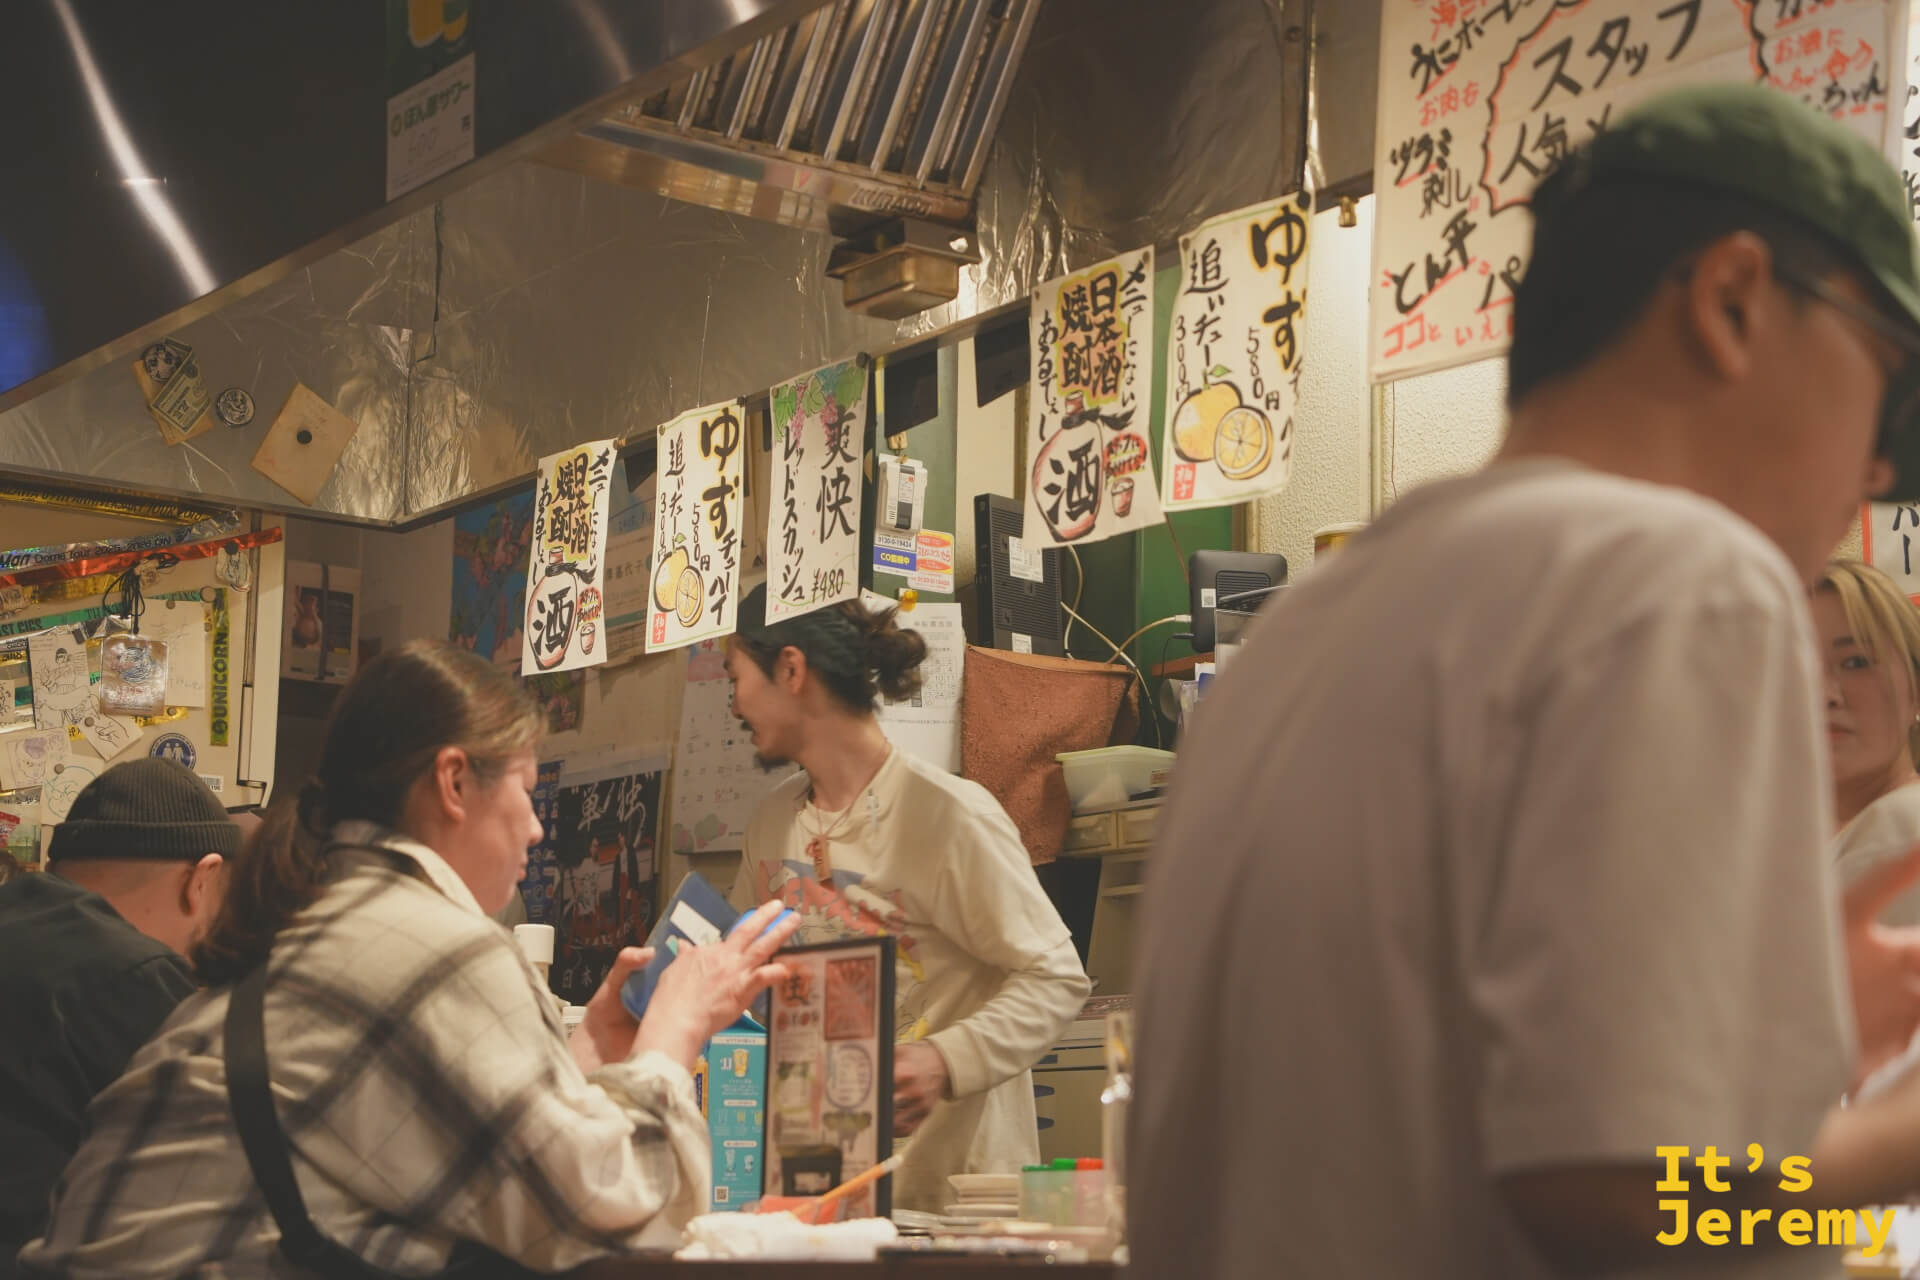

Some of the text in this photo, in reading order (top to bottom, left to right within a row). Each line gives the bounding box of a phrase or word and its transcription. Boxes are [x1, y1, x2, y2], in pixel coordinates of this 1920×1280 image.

[1531, 0, 1705, 112] スタッフ
[1391, 208, 1478, 315] とん平
[1059, 285, 1093, 389] 焼酎
[1089, 271, 1122, 398] 日本酒
[1119, 261, 1148, 408] メニューにない
[548, 461, 576, 544] 焼酎
[571, 452, 591, 554] 日本酒
[588, 448, 610, 567] メニューにない
[700, 407, 740, 626] ゆずチューハイ
[781, 425, 805, 602] レッドスカッシュ
[816, 404, 857, 545] 爽快
[1043, 437, 1101, 525] 酒
[532, 586, 576, 656] 酒
[811, 567, 845, 604] ¥480
[213, 631, 229, 723] UNICORN
